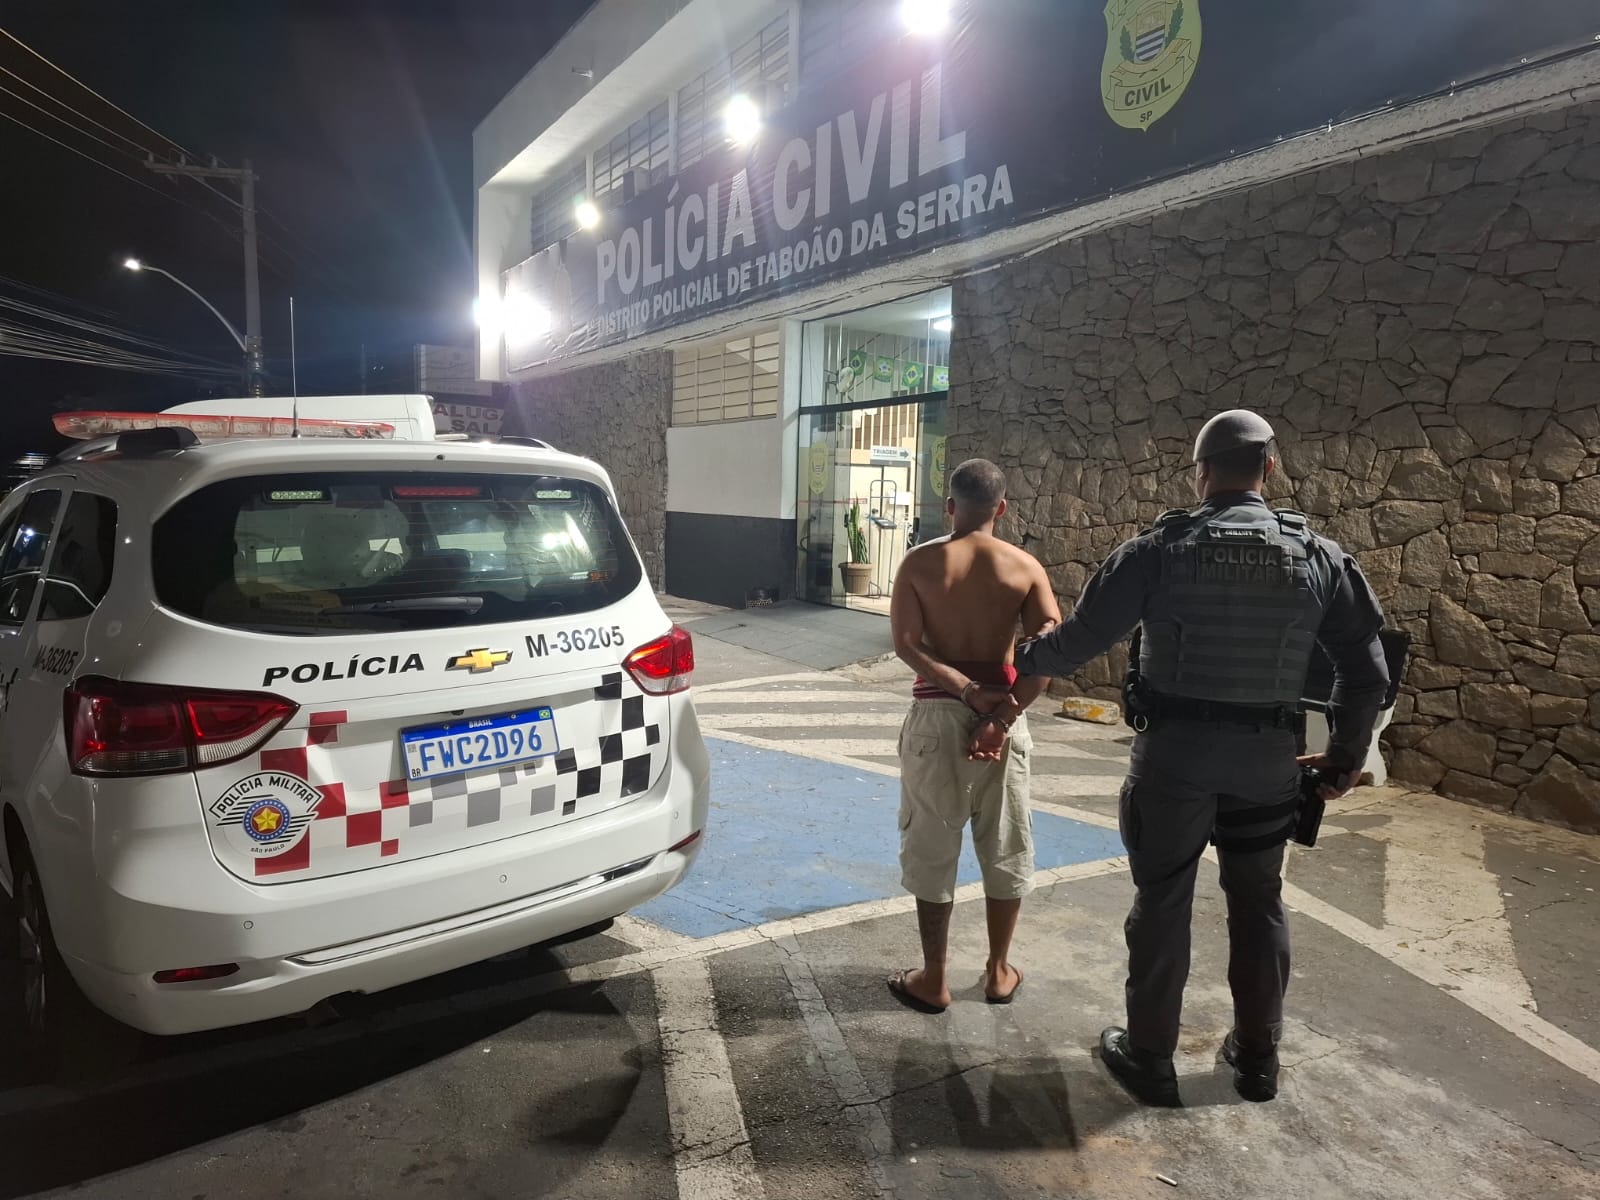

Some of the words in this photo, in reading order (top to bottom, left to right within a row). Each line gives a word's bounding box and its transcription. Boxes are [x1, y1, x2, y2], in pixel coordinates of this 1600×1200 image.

[1124, 77, 1172, 107] CIVIL
[1139, 110, 1153, 123] SP
[596, 167, 757, 304] POLÍCIA
[772, 62, 967, 231] CIVIL
[598, 297, 650, 337] DISTRITO
[652, 279, 724, 322] POLICIAL
[726, 263, 752, 294] DE
[755, 225, 844, 283] TABOÃO
[850, 211, 888, 255] DA
[896, 164, 1015, 240] SERRA
[432, 403, 504, 422] ALUG
[450, 419, 502, 435] SAL
[1201, 544, 1278, 566] POLÍCIA
[1201, 563, 1278, 585] MILITAR
[524, 625, 625, 659] M-36205
[33, 644, 79, 676] M-36205
[262, 653, 425, 687] POLÍCIA
[468, 718, 493, 729] BRASIL
[419, 725, 543, 772] FWC2D96
[411, 768, 422, 778] BR
[216, 777, 264, 814] POLÍCIA
[268, 775, 315, 804] MILITAR
[249, 846, 263, 854] SÃO
[264, 843, 286, 854] PAULO
